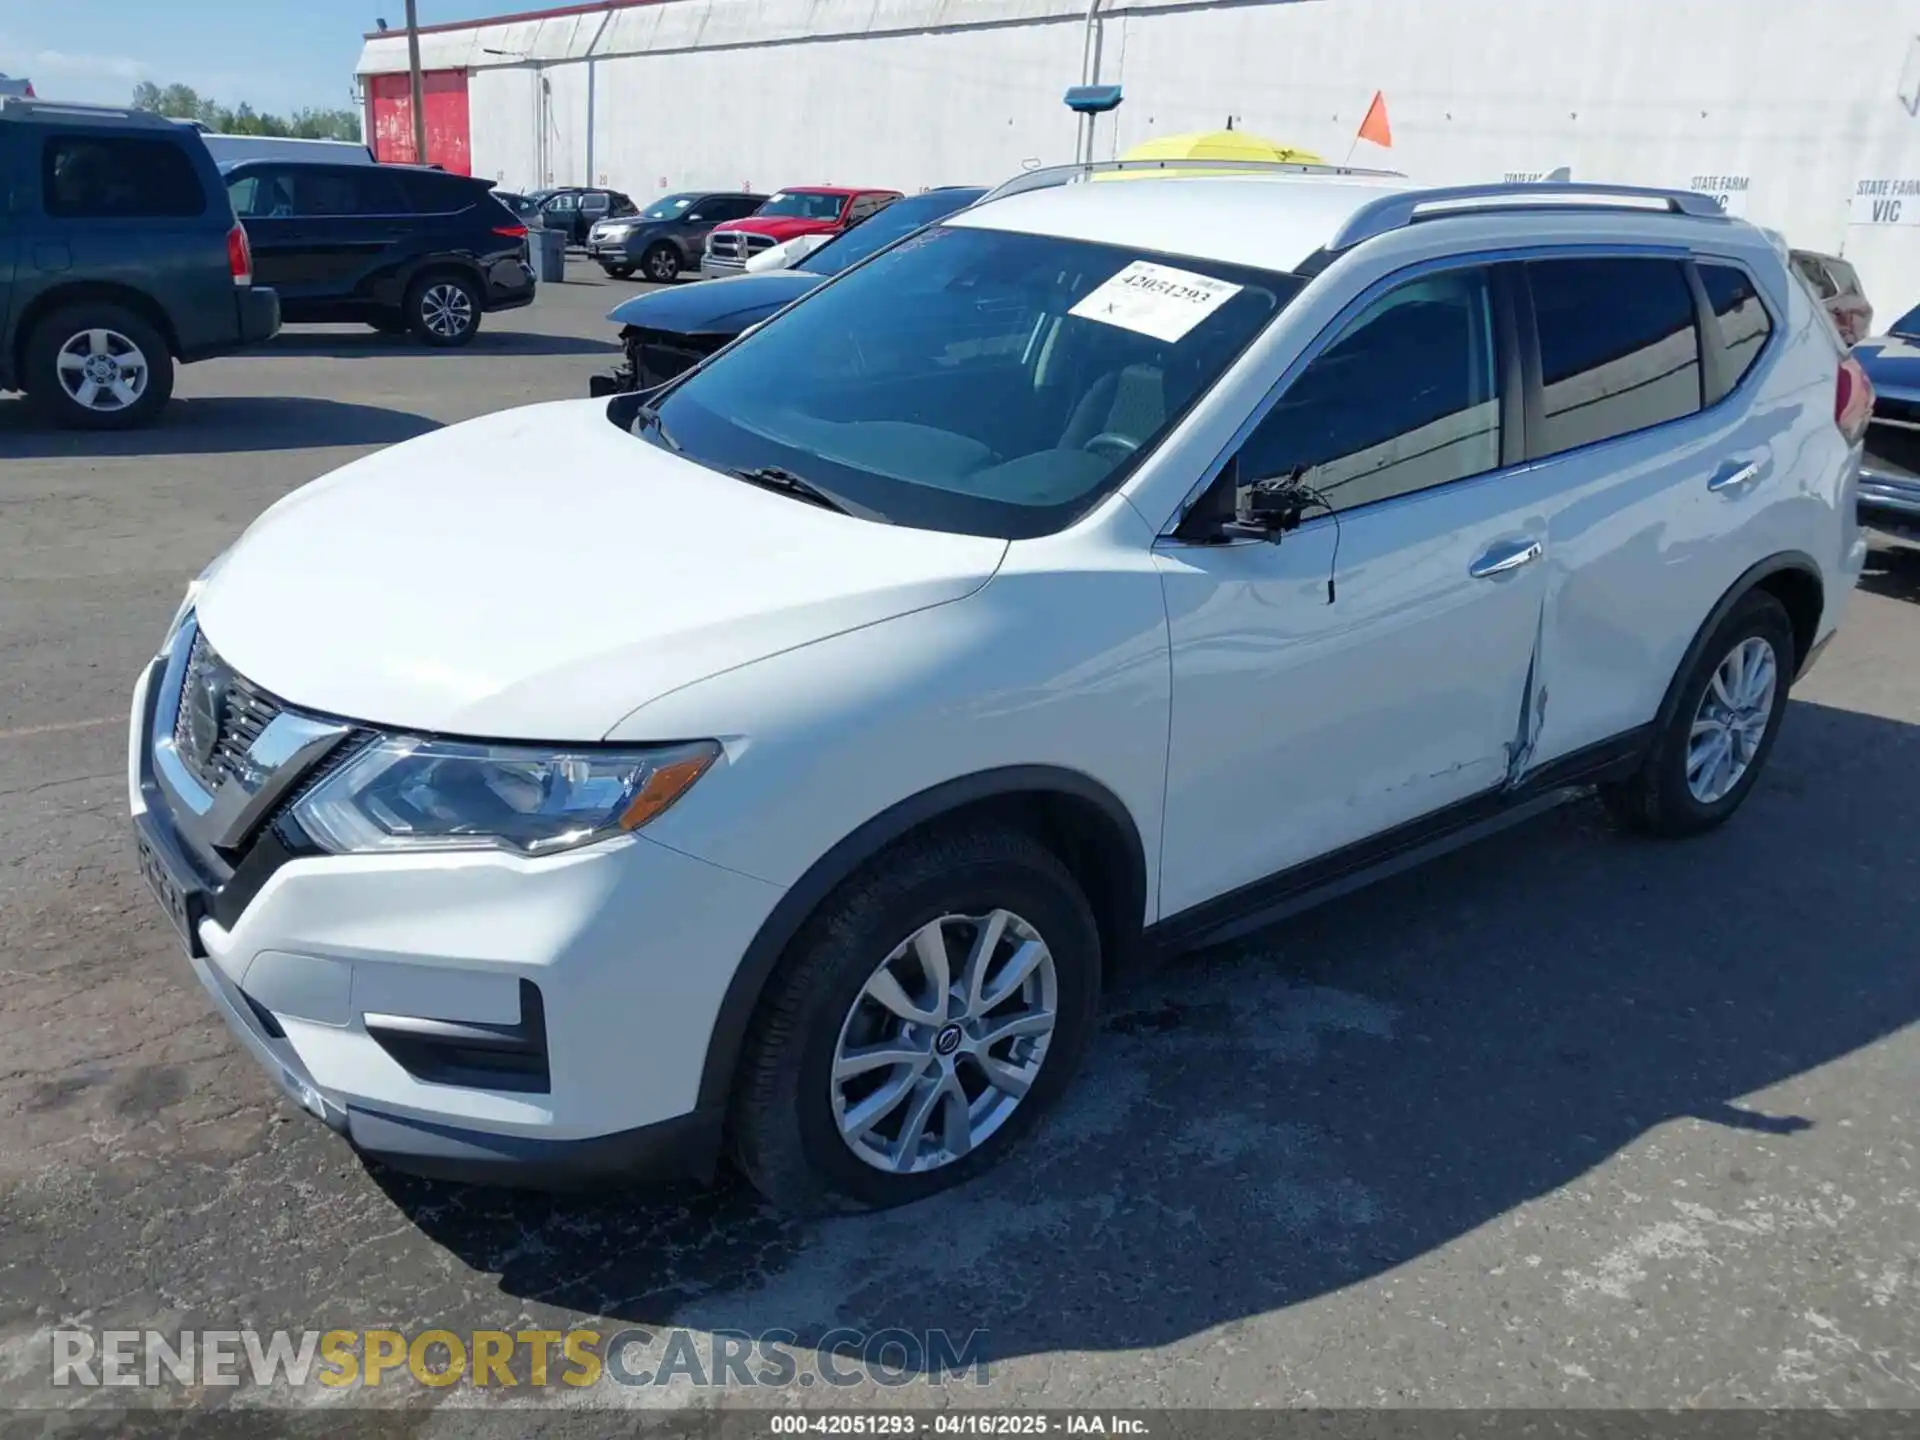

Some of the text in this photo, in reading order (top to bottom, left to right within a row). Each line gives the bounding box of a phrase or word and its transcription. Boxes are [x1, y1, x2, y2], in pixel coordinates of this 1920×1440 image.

[1691, 176, 1749, 191] STATE FARM
[1857, 179, 1890, 196] STATE
[1872, 199, 1902, 222] VIC
[1122, 274, 1212, 304] 42051293
